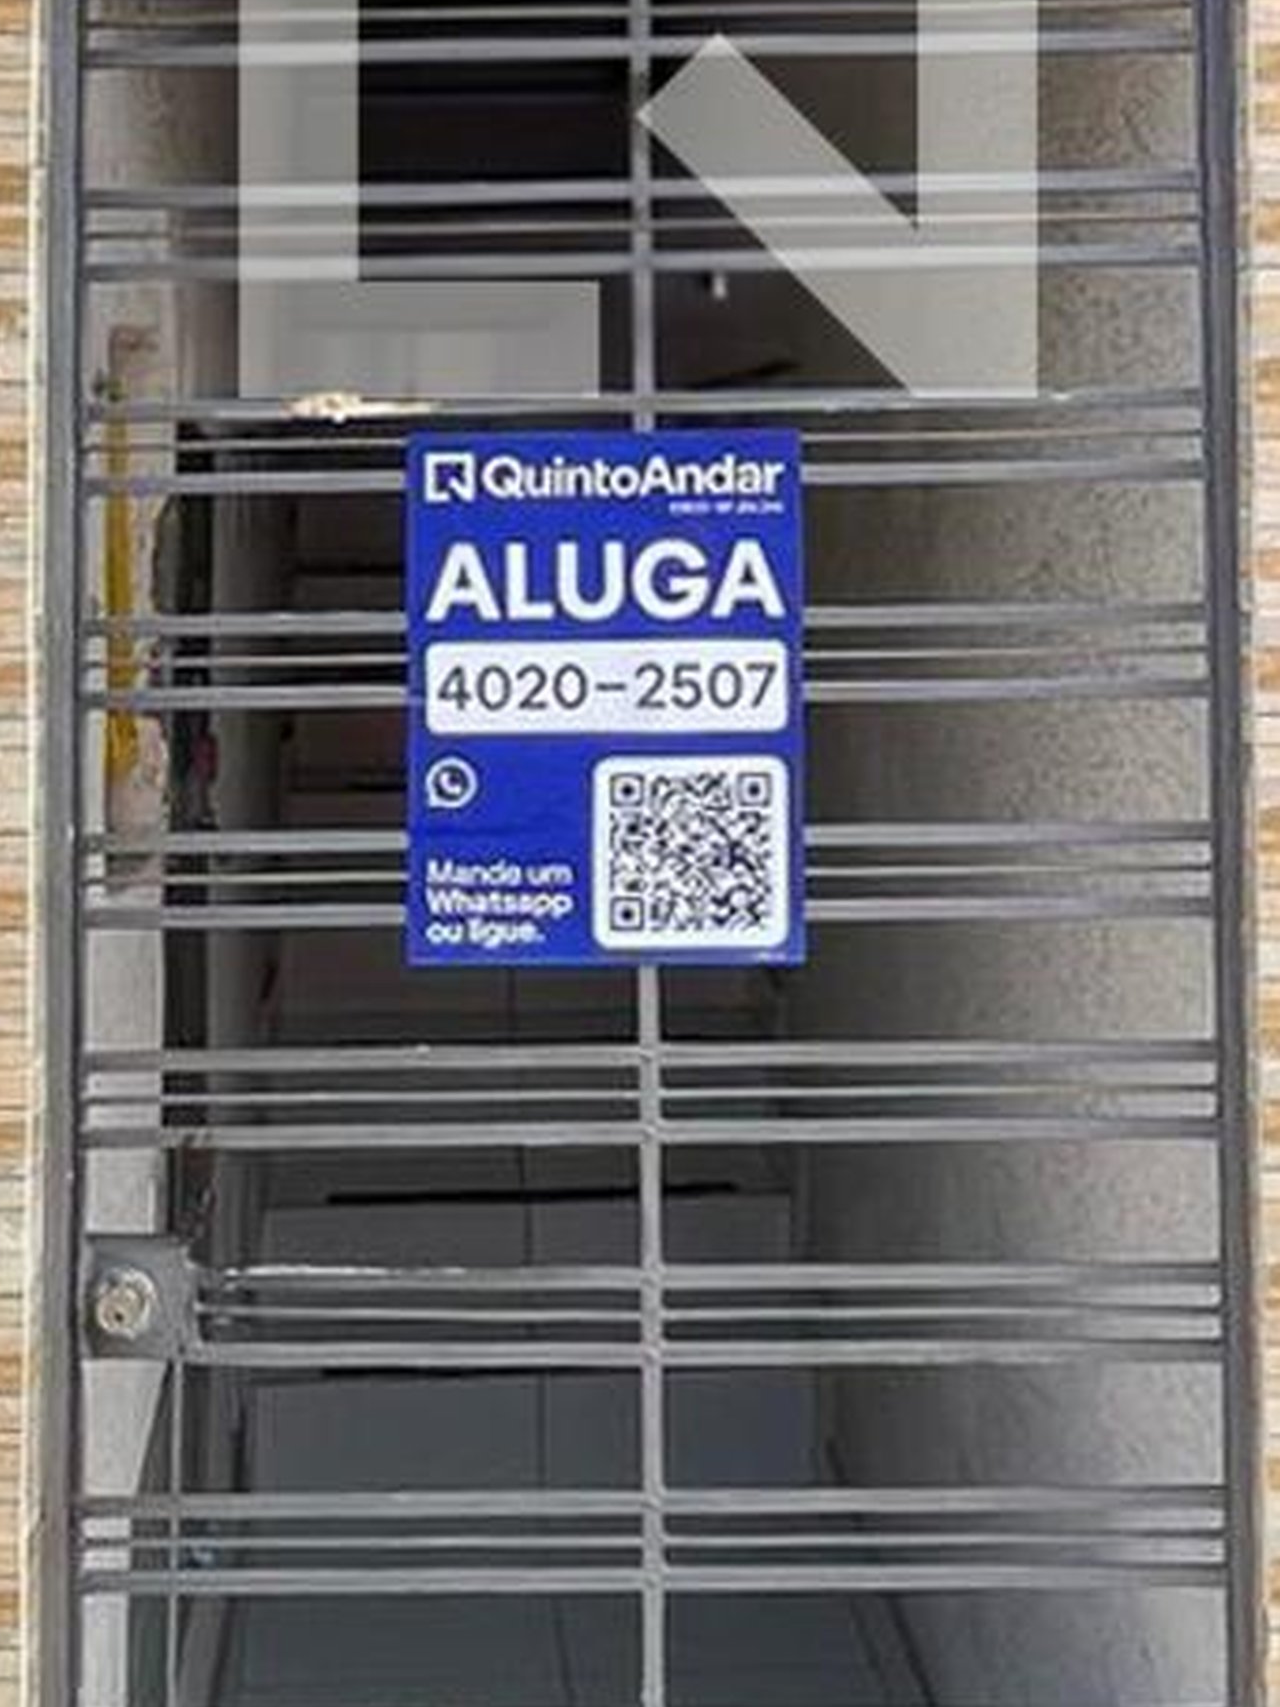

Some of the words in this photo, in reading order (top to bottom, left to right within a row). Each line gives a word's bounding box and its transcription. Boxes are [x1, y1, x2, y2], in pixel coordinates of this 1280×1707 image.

[480, 454, 784, 499] QuintoAndar
[427, 540, 784, 621] ALUGA
[438, 662, 778, 711] 4020-2507
[427, 859, 520, 885] Mande
[527, 865, 573, 885] um
[427, 888, 573, 918] Whatsapp
[427, 922, 463, 944] ou
[469, 919, 545, 948] ligue.
